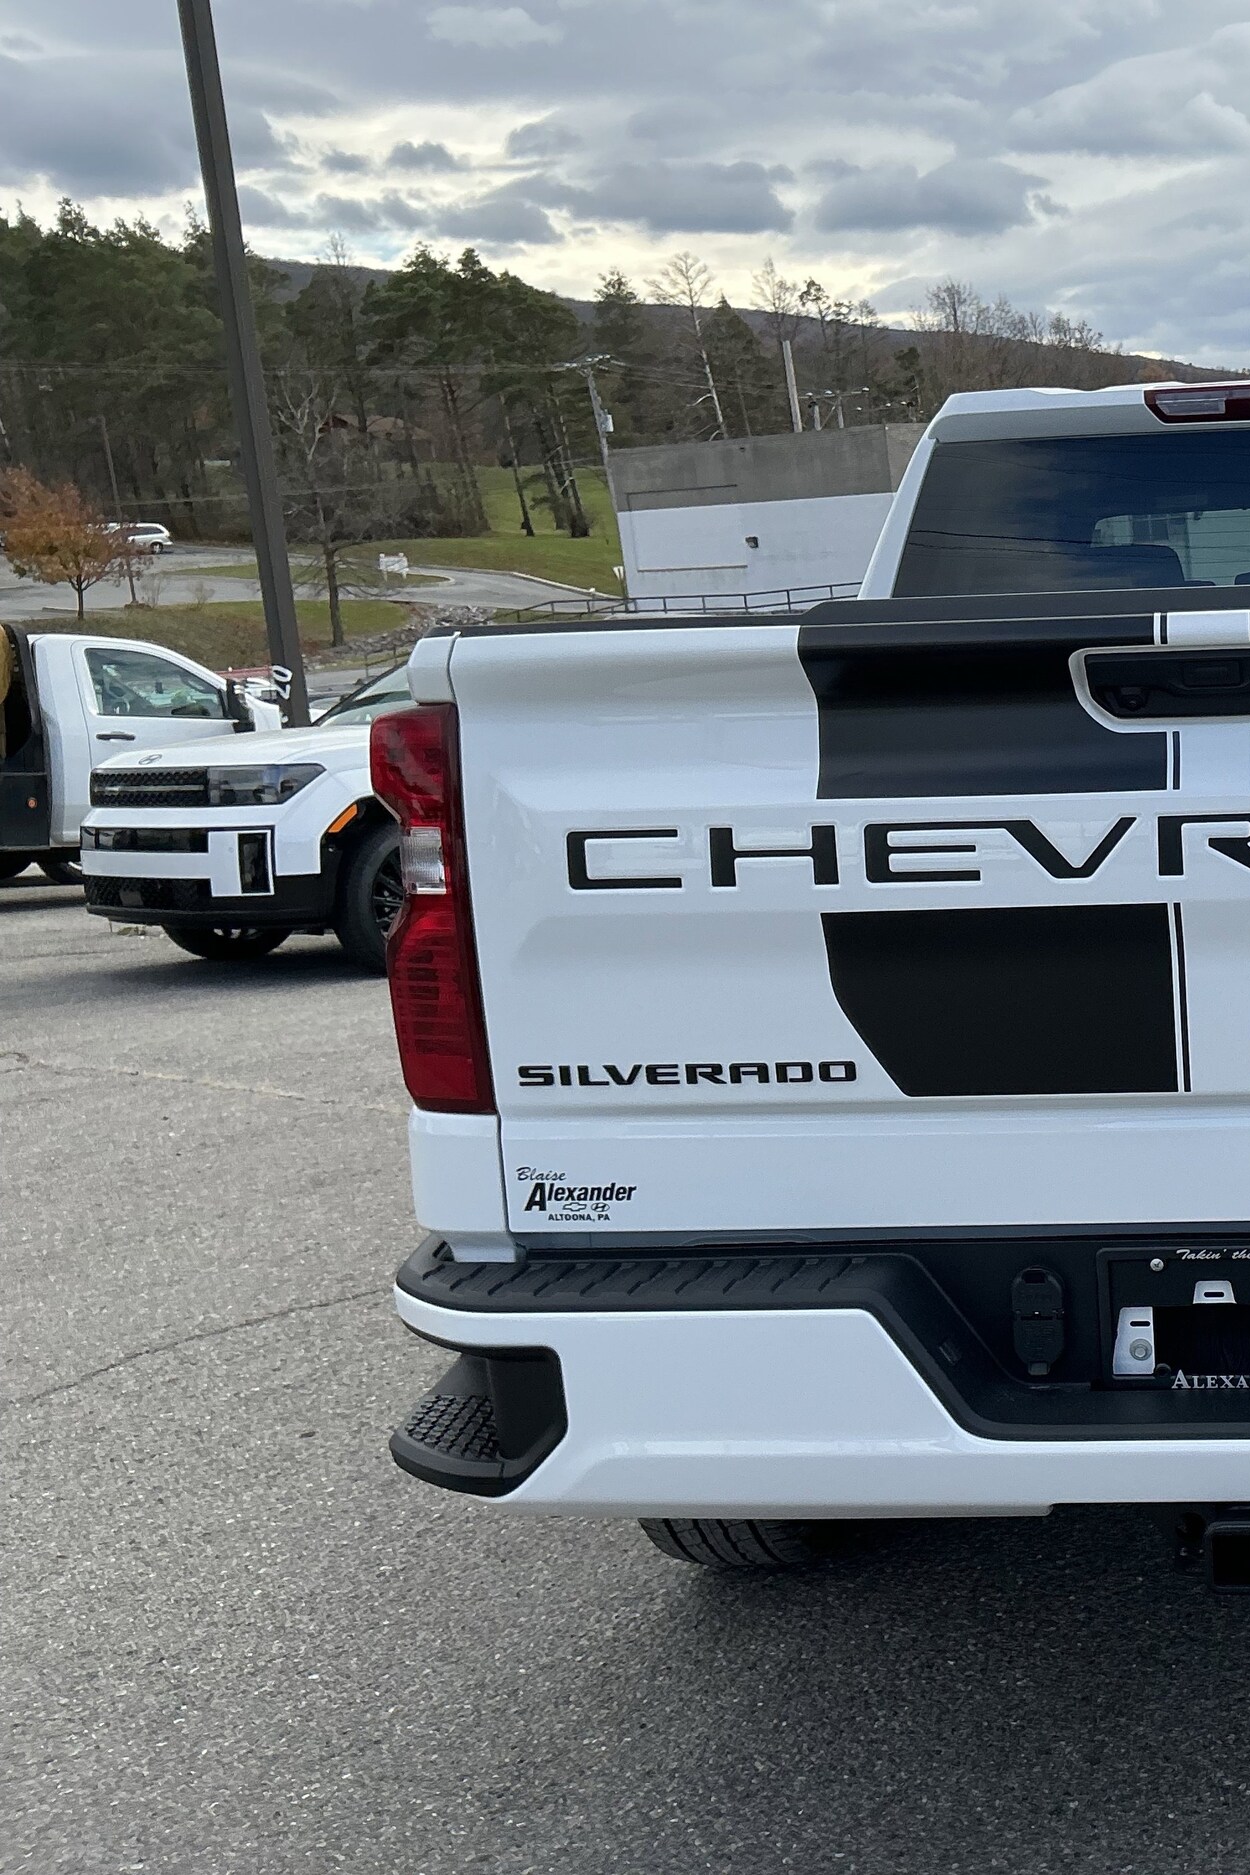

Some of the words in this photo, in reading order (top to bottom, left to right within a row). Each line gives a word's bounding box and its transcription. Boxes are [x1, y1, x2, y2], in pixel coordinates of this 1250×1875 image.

[518, 1060, 857, 1086] SILVERADO
[516, 1166, 567, 1181] Blaise
[524, 1182, 637, 1211] Alexander
[548, 1213, 596, 1222] ALTOONA,
[598, 1213, 610, 1221] PA
[1176, 1248, 1226, 1260] Takin'
